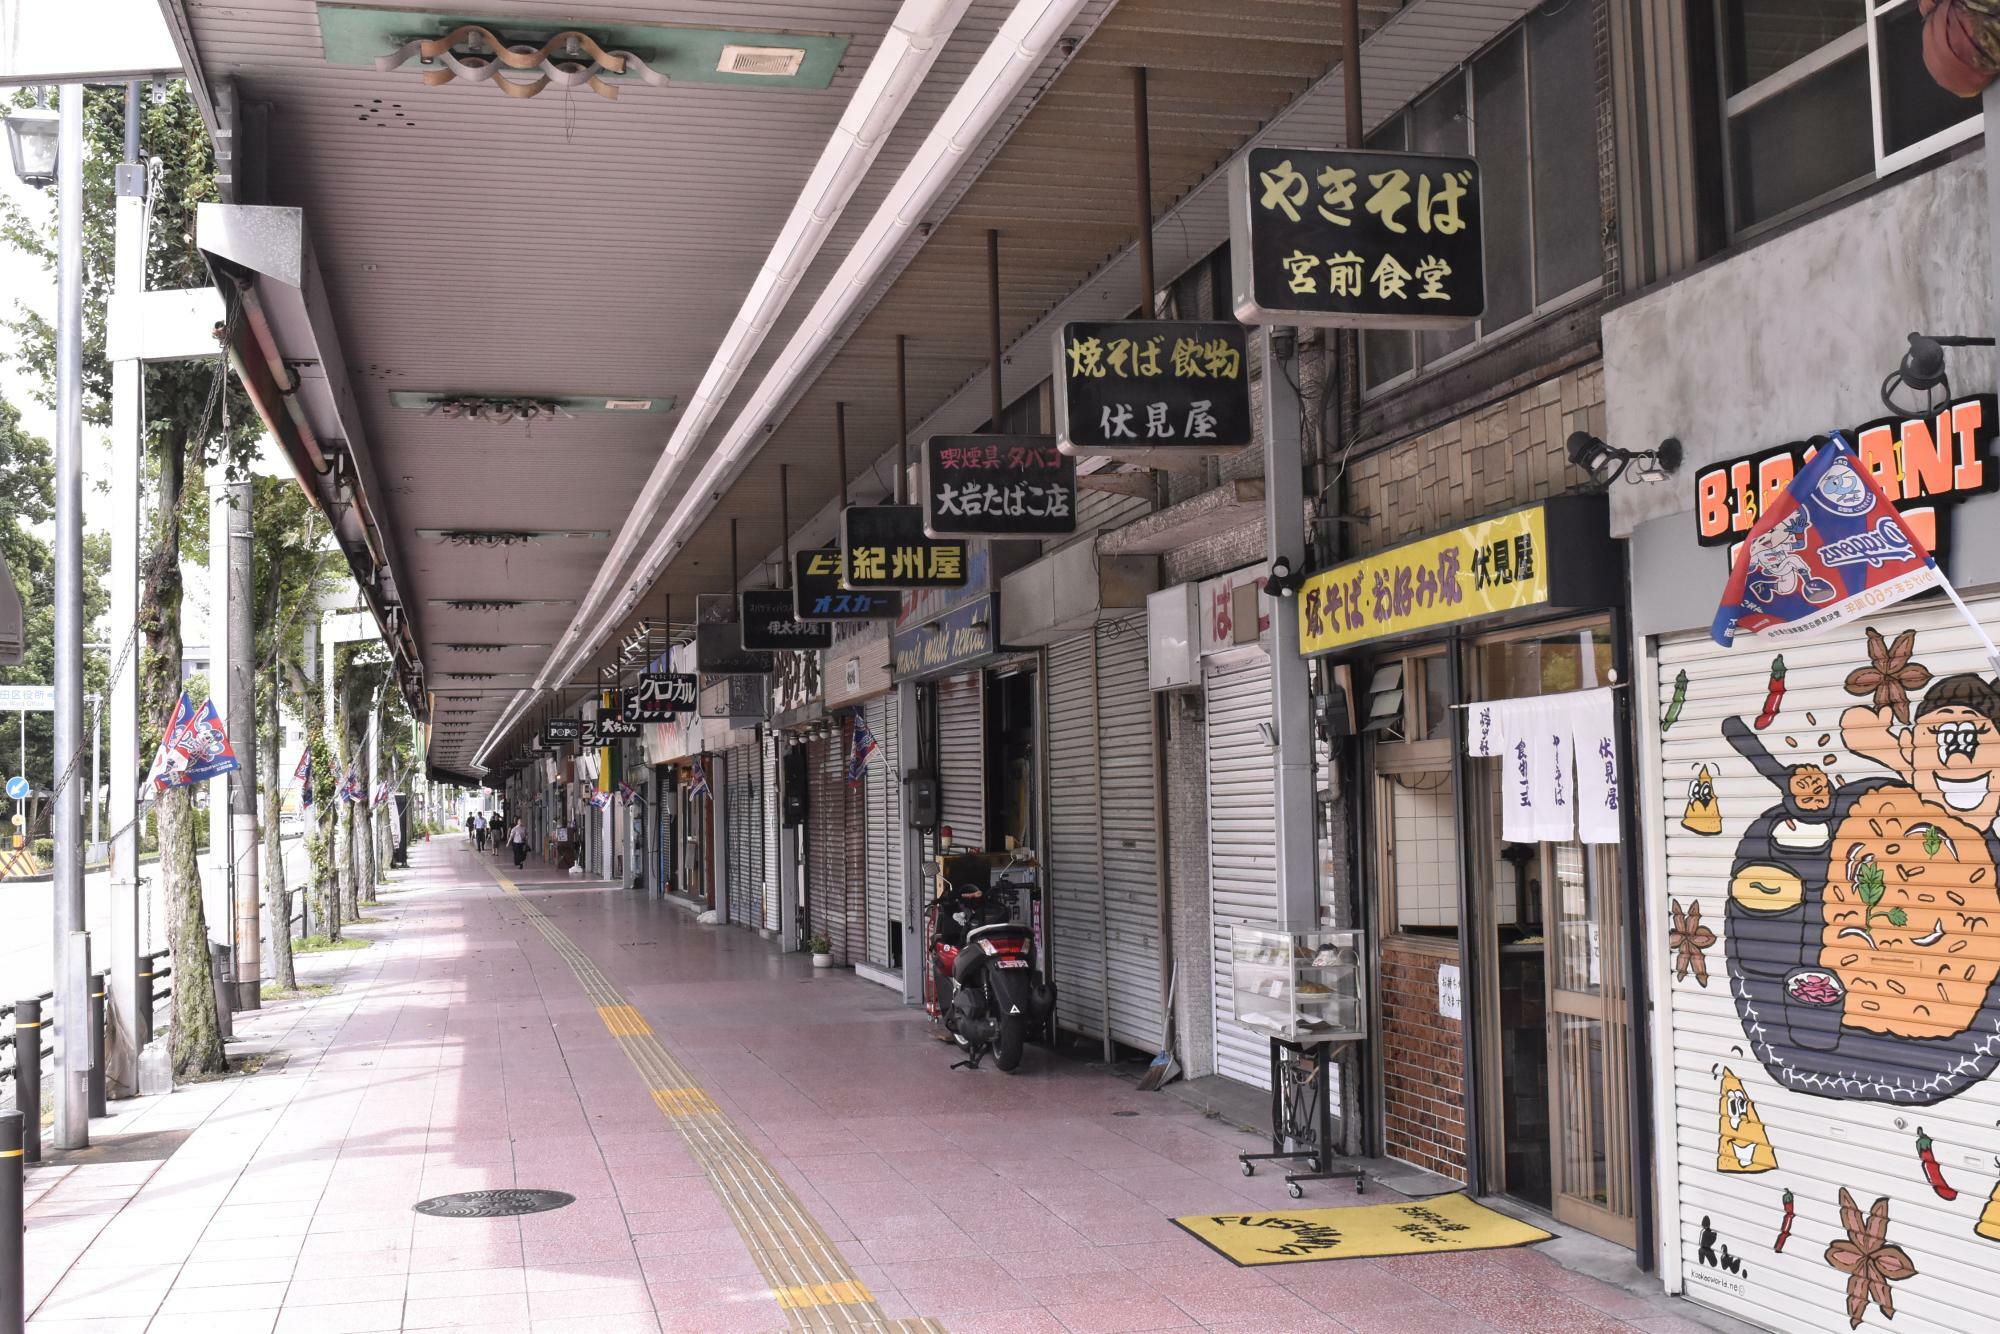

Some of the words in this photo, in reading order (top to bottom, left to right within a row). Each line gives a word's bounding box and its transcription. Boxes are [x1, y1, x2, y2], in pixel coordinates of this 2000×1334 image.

[1260, 160, 1472, 235] やきそば
[1282, 250, 1452, 300] 宮前食堂
[1067, 335, 1165, 378] 焼そば
[1170, 336, 1240, 380] 飲物
[1100, 400, 1217, 439] 伏見屋
[1698, 400, 1982, 538] BIRANI
[936, 480, 1070, 517] 大岩たばこ店
[852, 546, 961, 580] 紀州屋
[1471, 533, 1535, 591] 伏見屋
[813, 594, 888, 614] オスカー
[602, 718, 637, 734] 大ちゃん
[1598, 736, 1619, 810] 伏見屋
